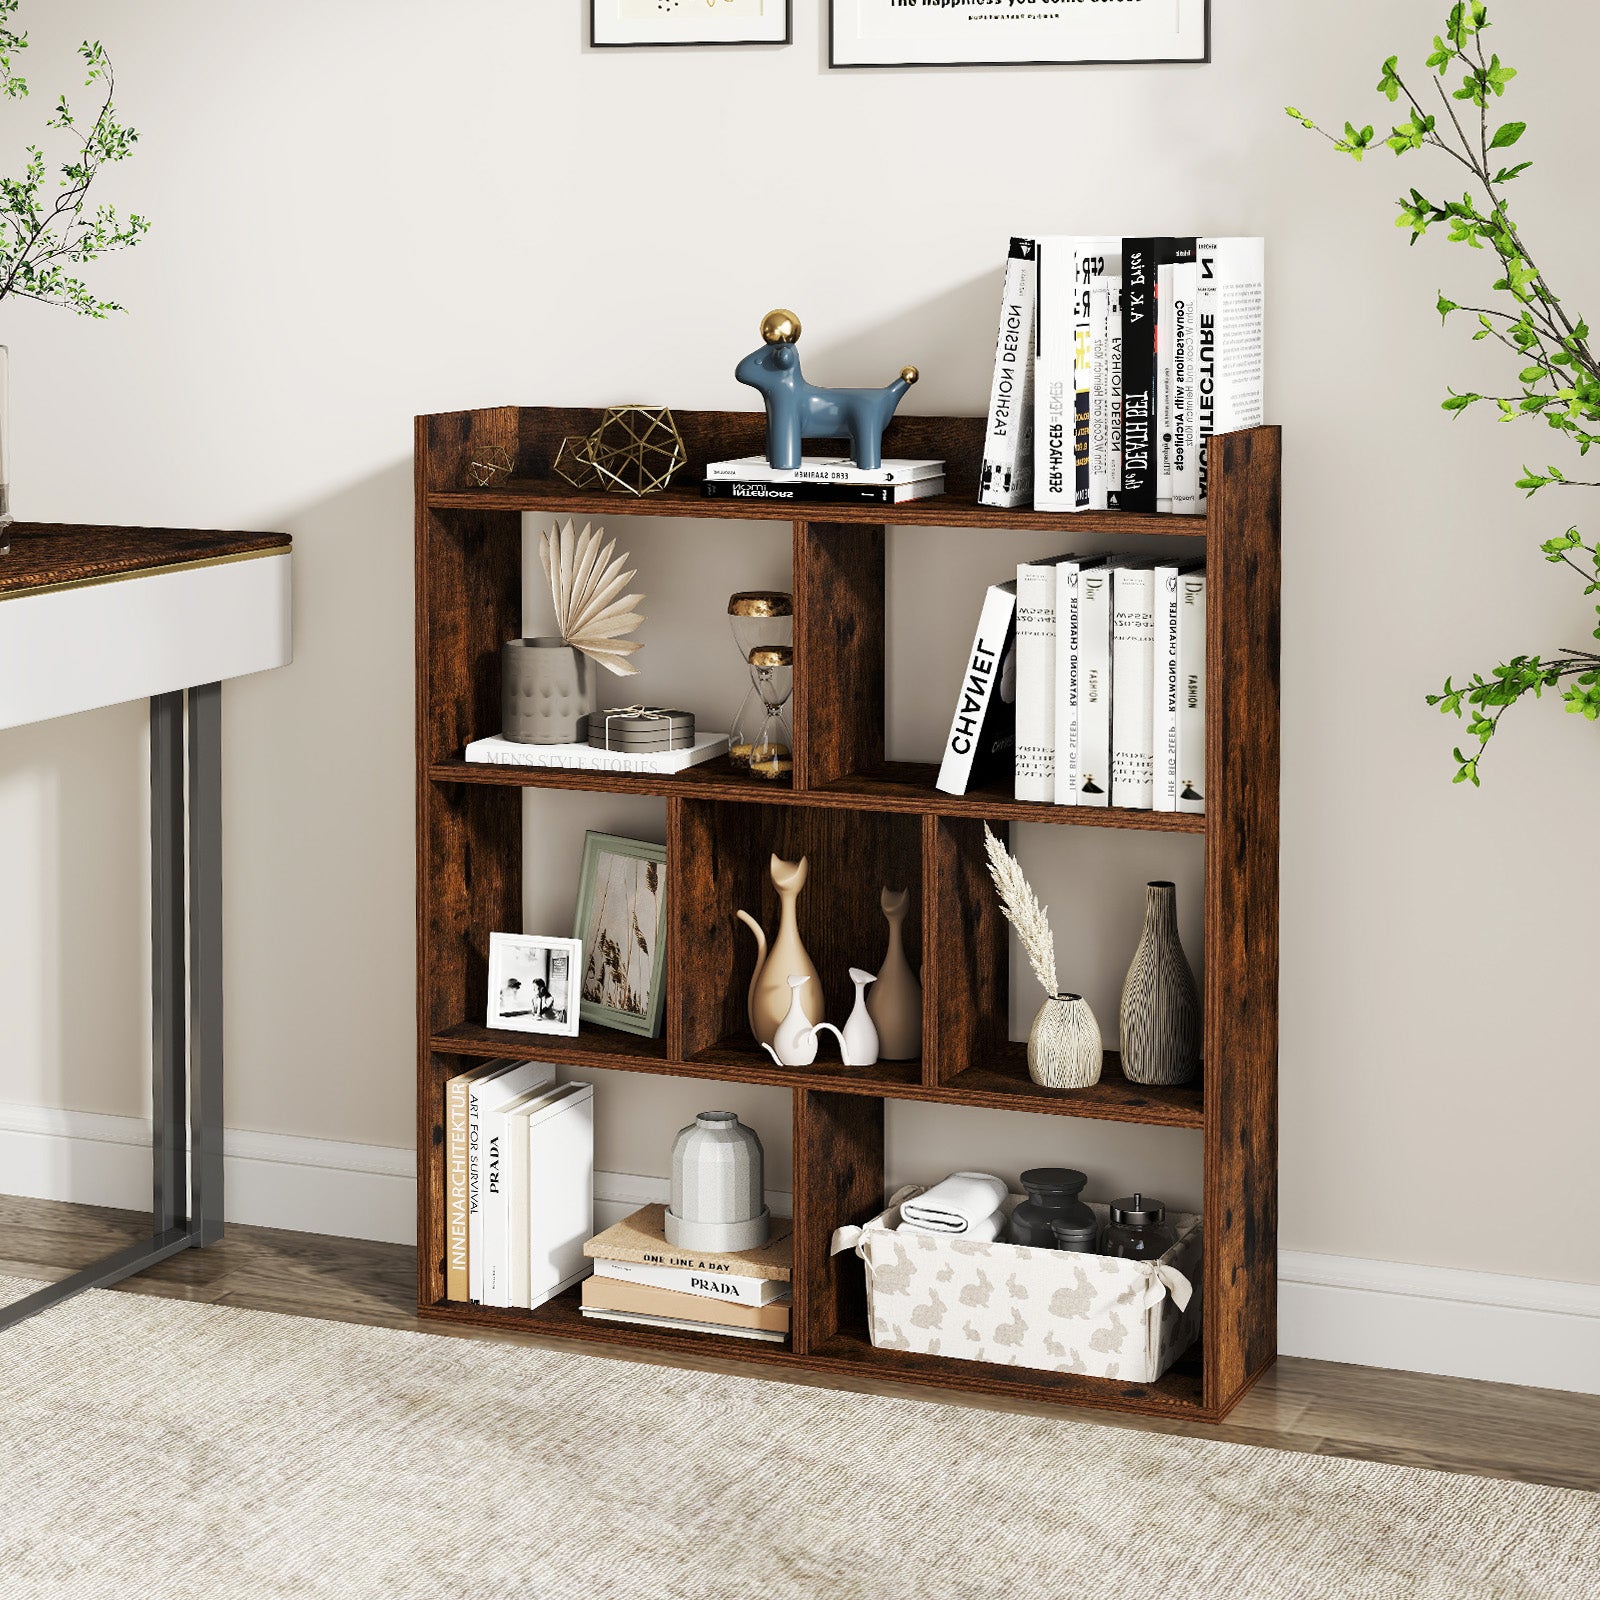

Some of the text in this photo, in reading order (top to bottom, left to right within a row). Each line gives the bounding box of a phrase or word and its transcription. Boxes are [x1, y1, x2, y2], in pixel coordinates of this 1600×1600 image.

[1086, 578, 1103, 601] Dior
[1184, 582, 1203, 605] Dior
[1088, 669, 1098, 703] FASHION
[1187, 674, 1198, 709] FASHION
[486, 751, 658, 773] MEN'S STYLE STORIES
[470, 1094, 479, 1215] ART FOR SURVIVAL
[489, 1136, 500, 1194] PRADA
[451, 1083, 466, 1271] INNENARCHITEKTUR
[643, 1254, 731, 1272] ONE LINE A DAY
[690, 1276, 740, 1297] PRADA
